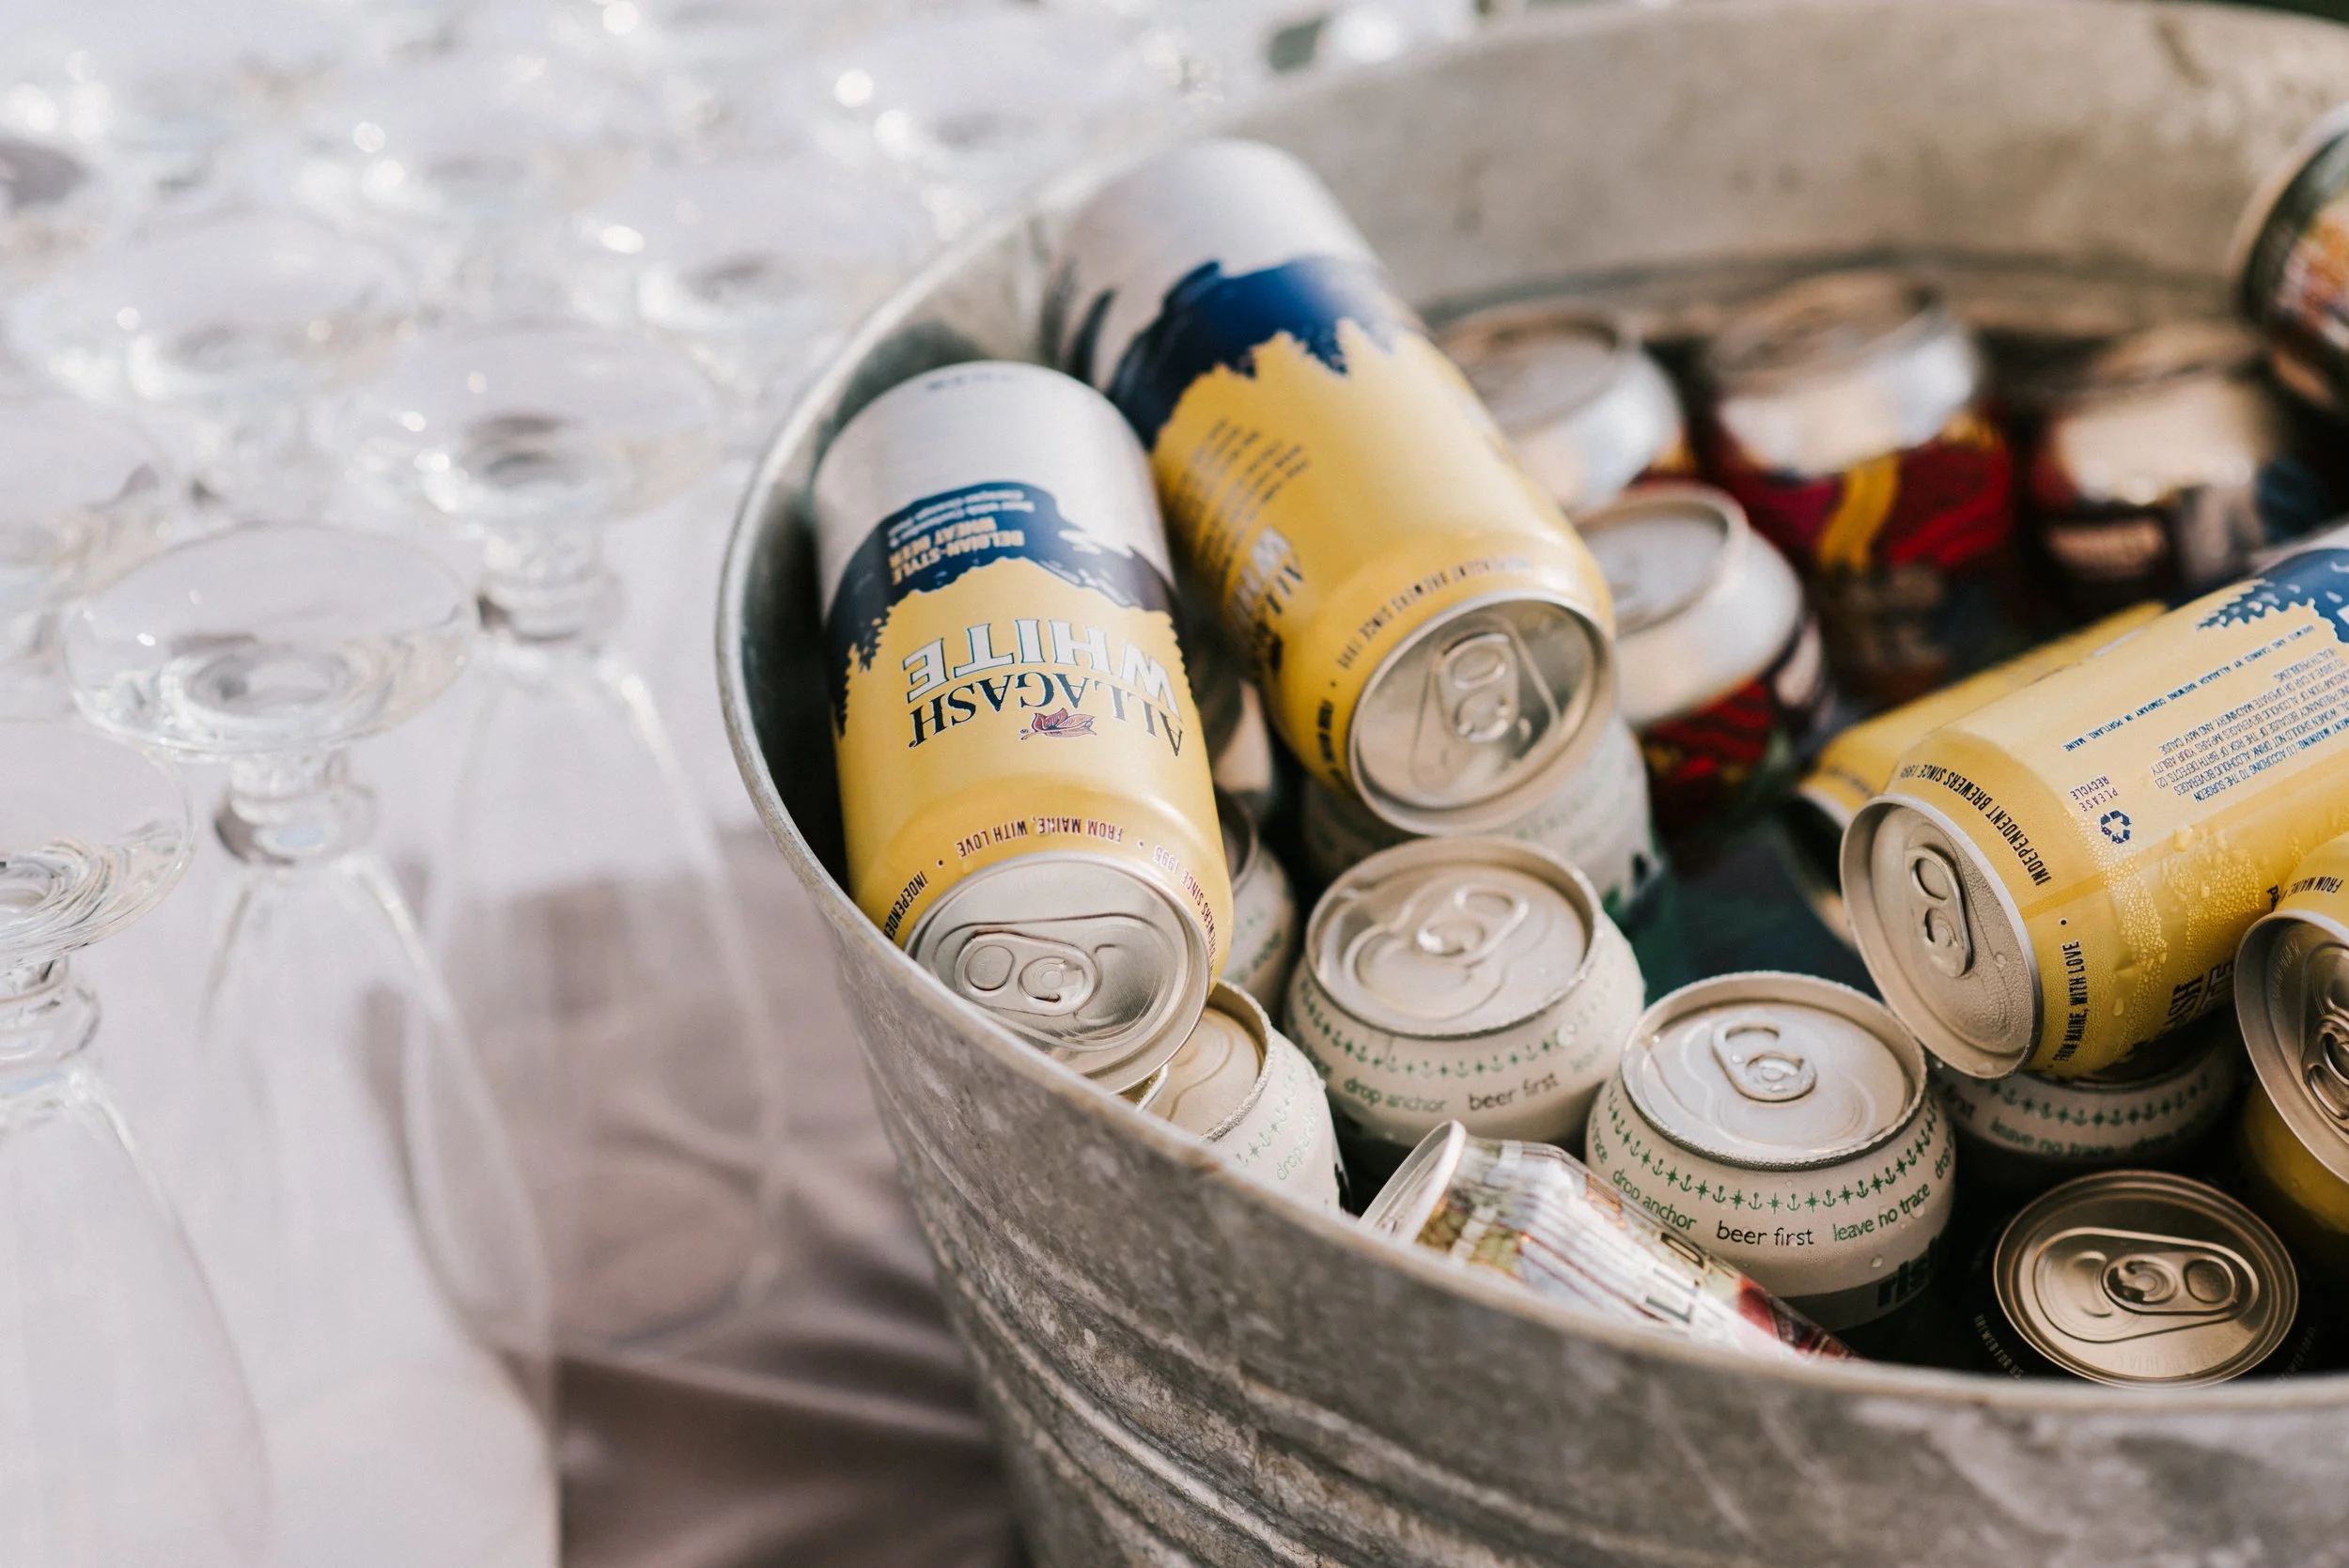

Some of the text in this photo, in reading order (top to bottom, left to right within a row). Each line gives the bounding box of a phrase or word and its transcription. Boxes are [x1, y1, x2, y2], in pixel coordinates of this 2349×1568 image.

[902, 618, 1180, 718] WHITE
[2199, 665, 2230, 684] ALLAGASH
[2167, 682, 2197, 700] BREWING
[2283, 681, 2295, 692] OR
[2299, 691, 2308, 701] OF
[2135, 697, 2166, 716] COMPANY
[2252, 687, 2284, 708] OPERATE
[2262, 695, 2298, 720] ALCOHOLIC
[2299, 691, 2338, 716] PREGNANCY
[908, 671, 1184, 757] ALLAGASH
[2212, 702, 2254, 728] MACHINERY,
[2267, 710, 2298, 733] BECAUSE
[2086, 719, 2123, 740] PORTLAND,
[2183, 729, 2200, 743] MAY
[2199, 722, 2214, 735] AND
[2221, 713, 2263, 739] BEVERAGES
[2258, 726, 2268, 737] OF
[2063, 737, 2085, 751] MAINE
[2158, 737, 2184, 755] CAUSE
[2194, 733, 2222, 753] IMPAIRS
[2228, 737, 2244, 753] RISK
[2243, 731, 2258, 745] THE
[2296, 728, 2329, 749] WARNING:
[2173, 707, 2338, 795] WOMEN SHOULD NOT DRINK ALCOHOLIC BEVERAGES
[2176, 746, 2196, 762] YOUR
[2197, 751, 2218, 768] BIRTH
[2218, 746, 2228, 757] OF
[2248, 749, 2287, 774] ACCORDING
[1916, 763, 1947, 783] SINCE
[2150, 755, 2176, 774] ABILITY
[2166, 761, 2199, 784] DEFECTS.
[2238, 768, 2248, 779] TO
[2069, 775, 2109, 800] RECYCLE
[2225, 773, 2239, 785] THE
[1943, 770, 1993, 811] BREWERS
[2077, 787, 2118, 811] PLEASE
[2193, 780, 2225, 801] SURGEON
[956, 816, 1123, 858] FROM MAINE, WITH LOVE
[1984, 803, 2052, 886] INDEPENDENT
[1152, 846, 1179, 873] 1995
[1179, 869, 1205, 906] SINCE
[2312, 877, 2343, 893] FROM
[2061, 940, 2085, 974] LOVE
[2065, 974, 2091, 1006] WITH
[2063, 1007, 2091, 1041] MAINE,
[1342, 1075, 1383, 1106] drop
[1466, 1081, 1518, 1112] beer
[1611, 1168, 1641, 1200] drop
[1641, 1195, 1697, 1230] anchor
[1716, 1219, 1766, 1245] beer
[1773, 1226, 1813, 1246] first
[1833, 1218, 1875, 1242] leave
[1875, 1206, 1900, 1228] no
[1897, 1183, 1932, 1215] trace
